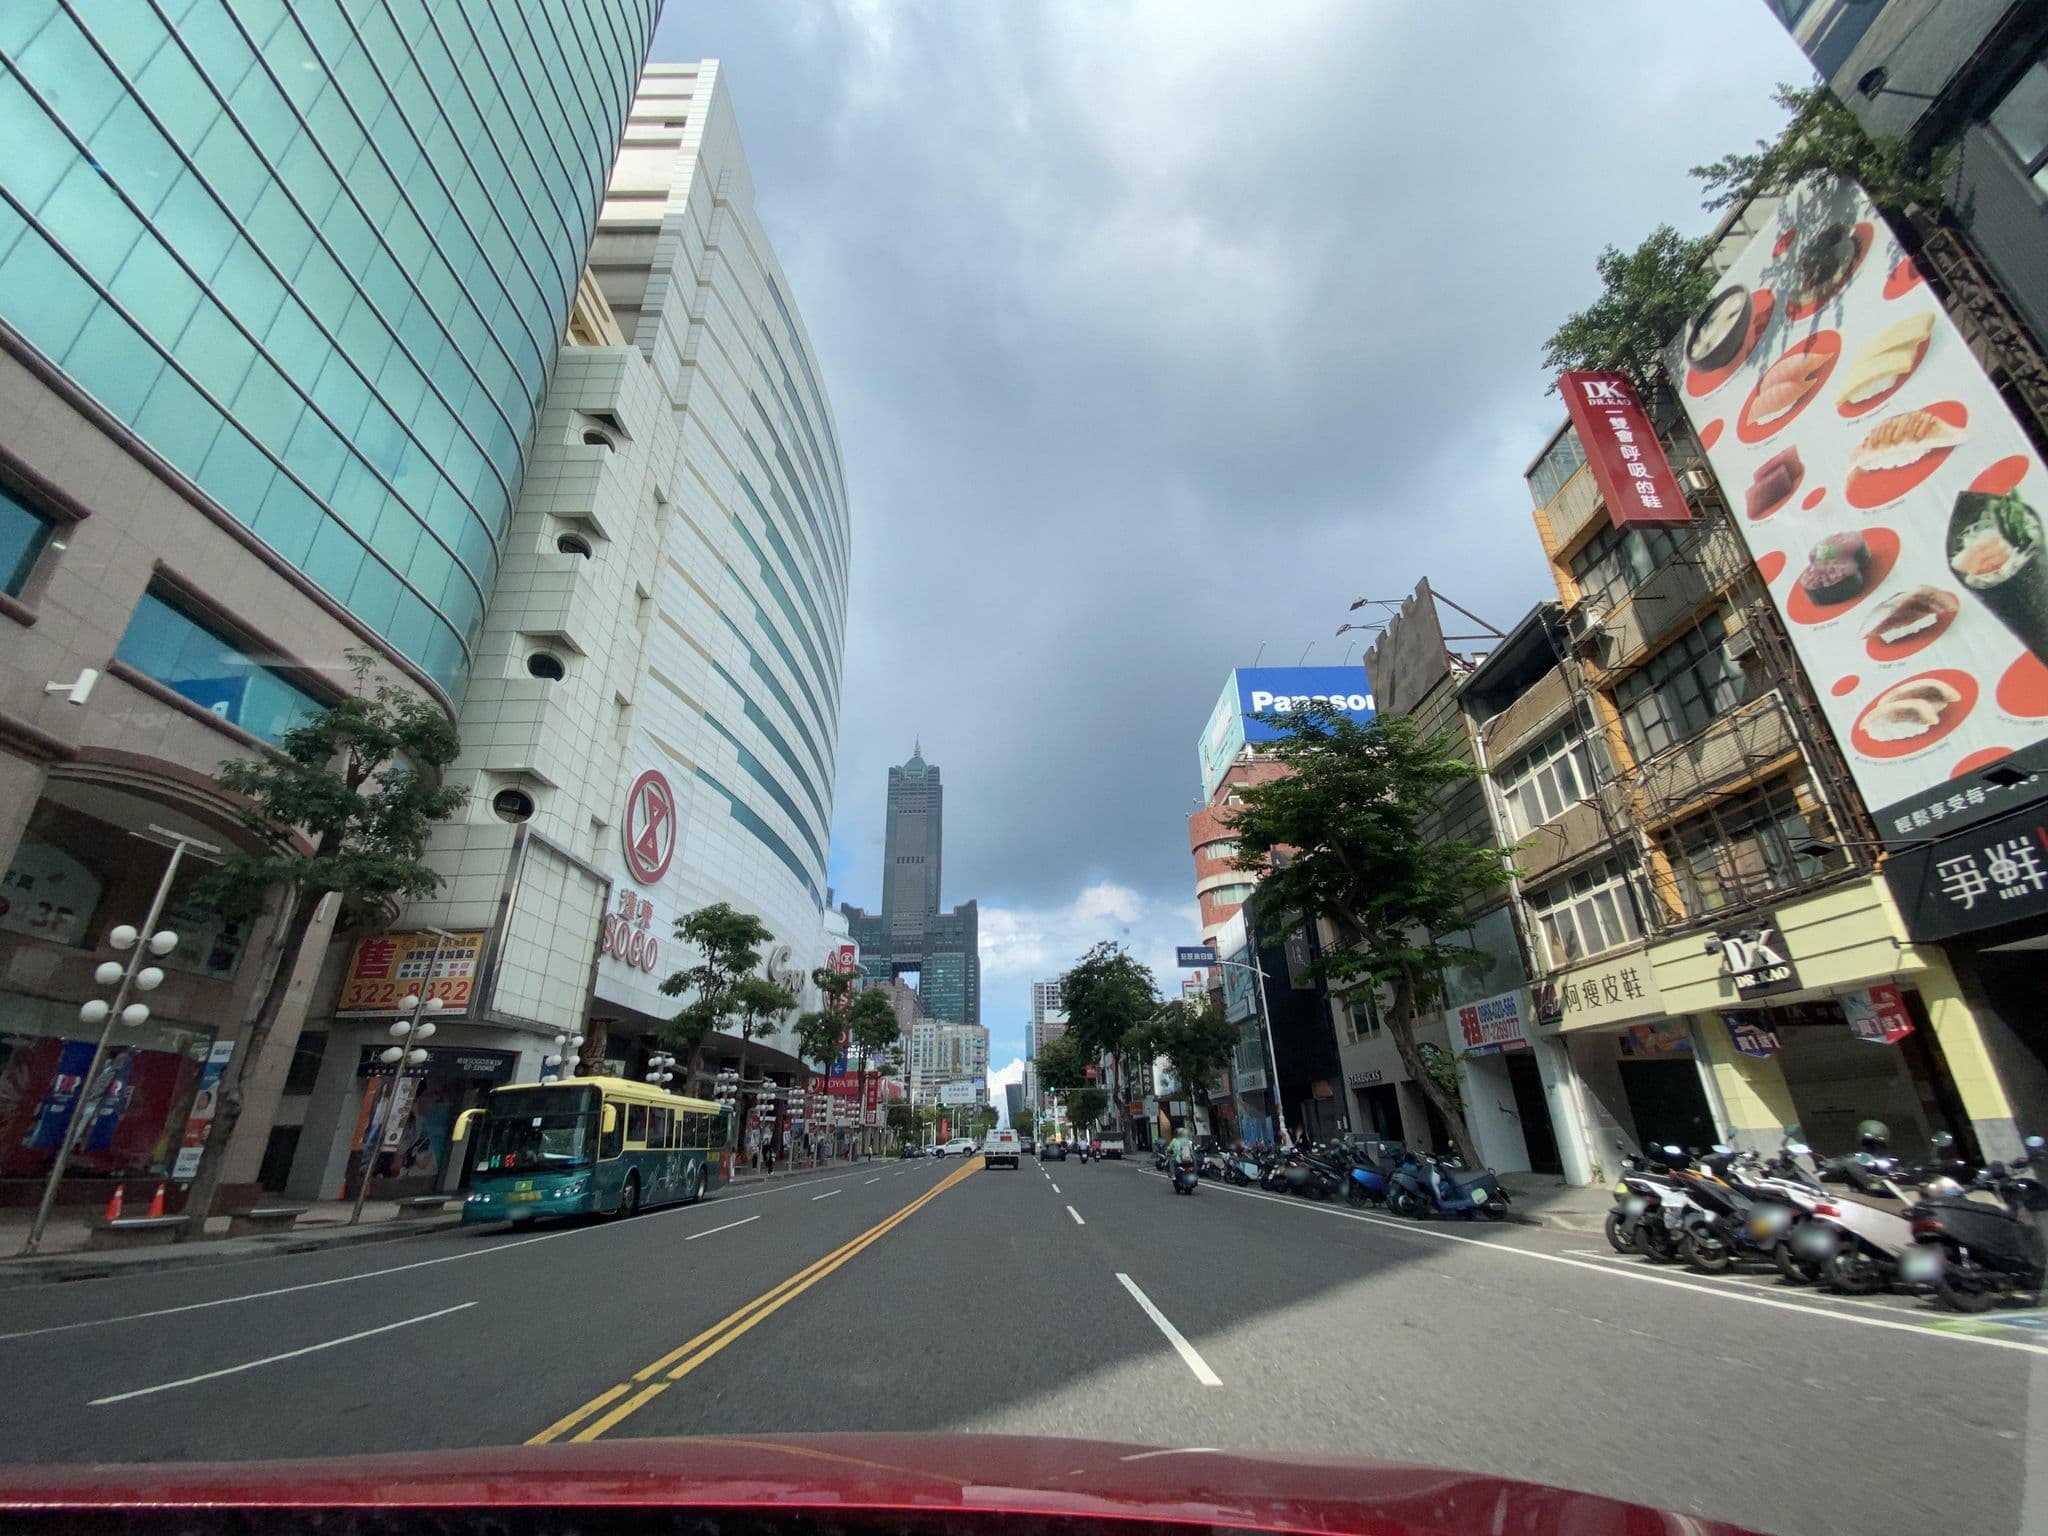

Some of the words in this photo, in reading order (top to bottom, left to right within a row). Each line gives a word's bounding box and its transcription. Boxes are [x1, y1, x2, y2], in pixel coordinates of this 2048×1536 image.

[1580, 381, 1627, 398] DK
[1588, 398, 1632, 406] DR.KAO
[1604, 410, 1663, 508] 一雙會呼吸的鞋
[1894, 774, 2040, 834] 輕鬆享受每一。
[1936, 835, 2048, 910] 爭鮮
[353, 937, 398, 980] 售
[602, 912, 658, 974] SOGO
[1562, 967, 1646, 1013] 阿瘦皮鞋
[1458, 1006, 1484, 1047] 租
